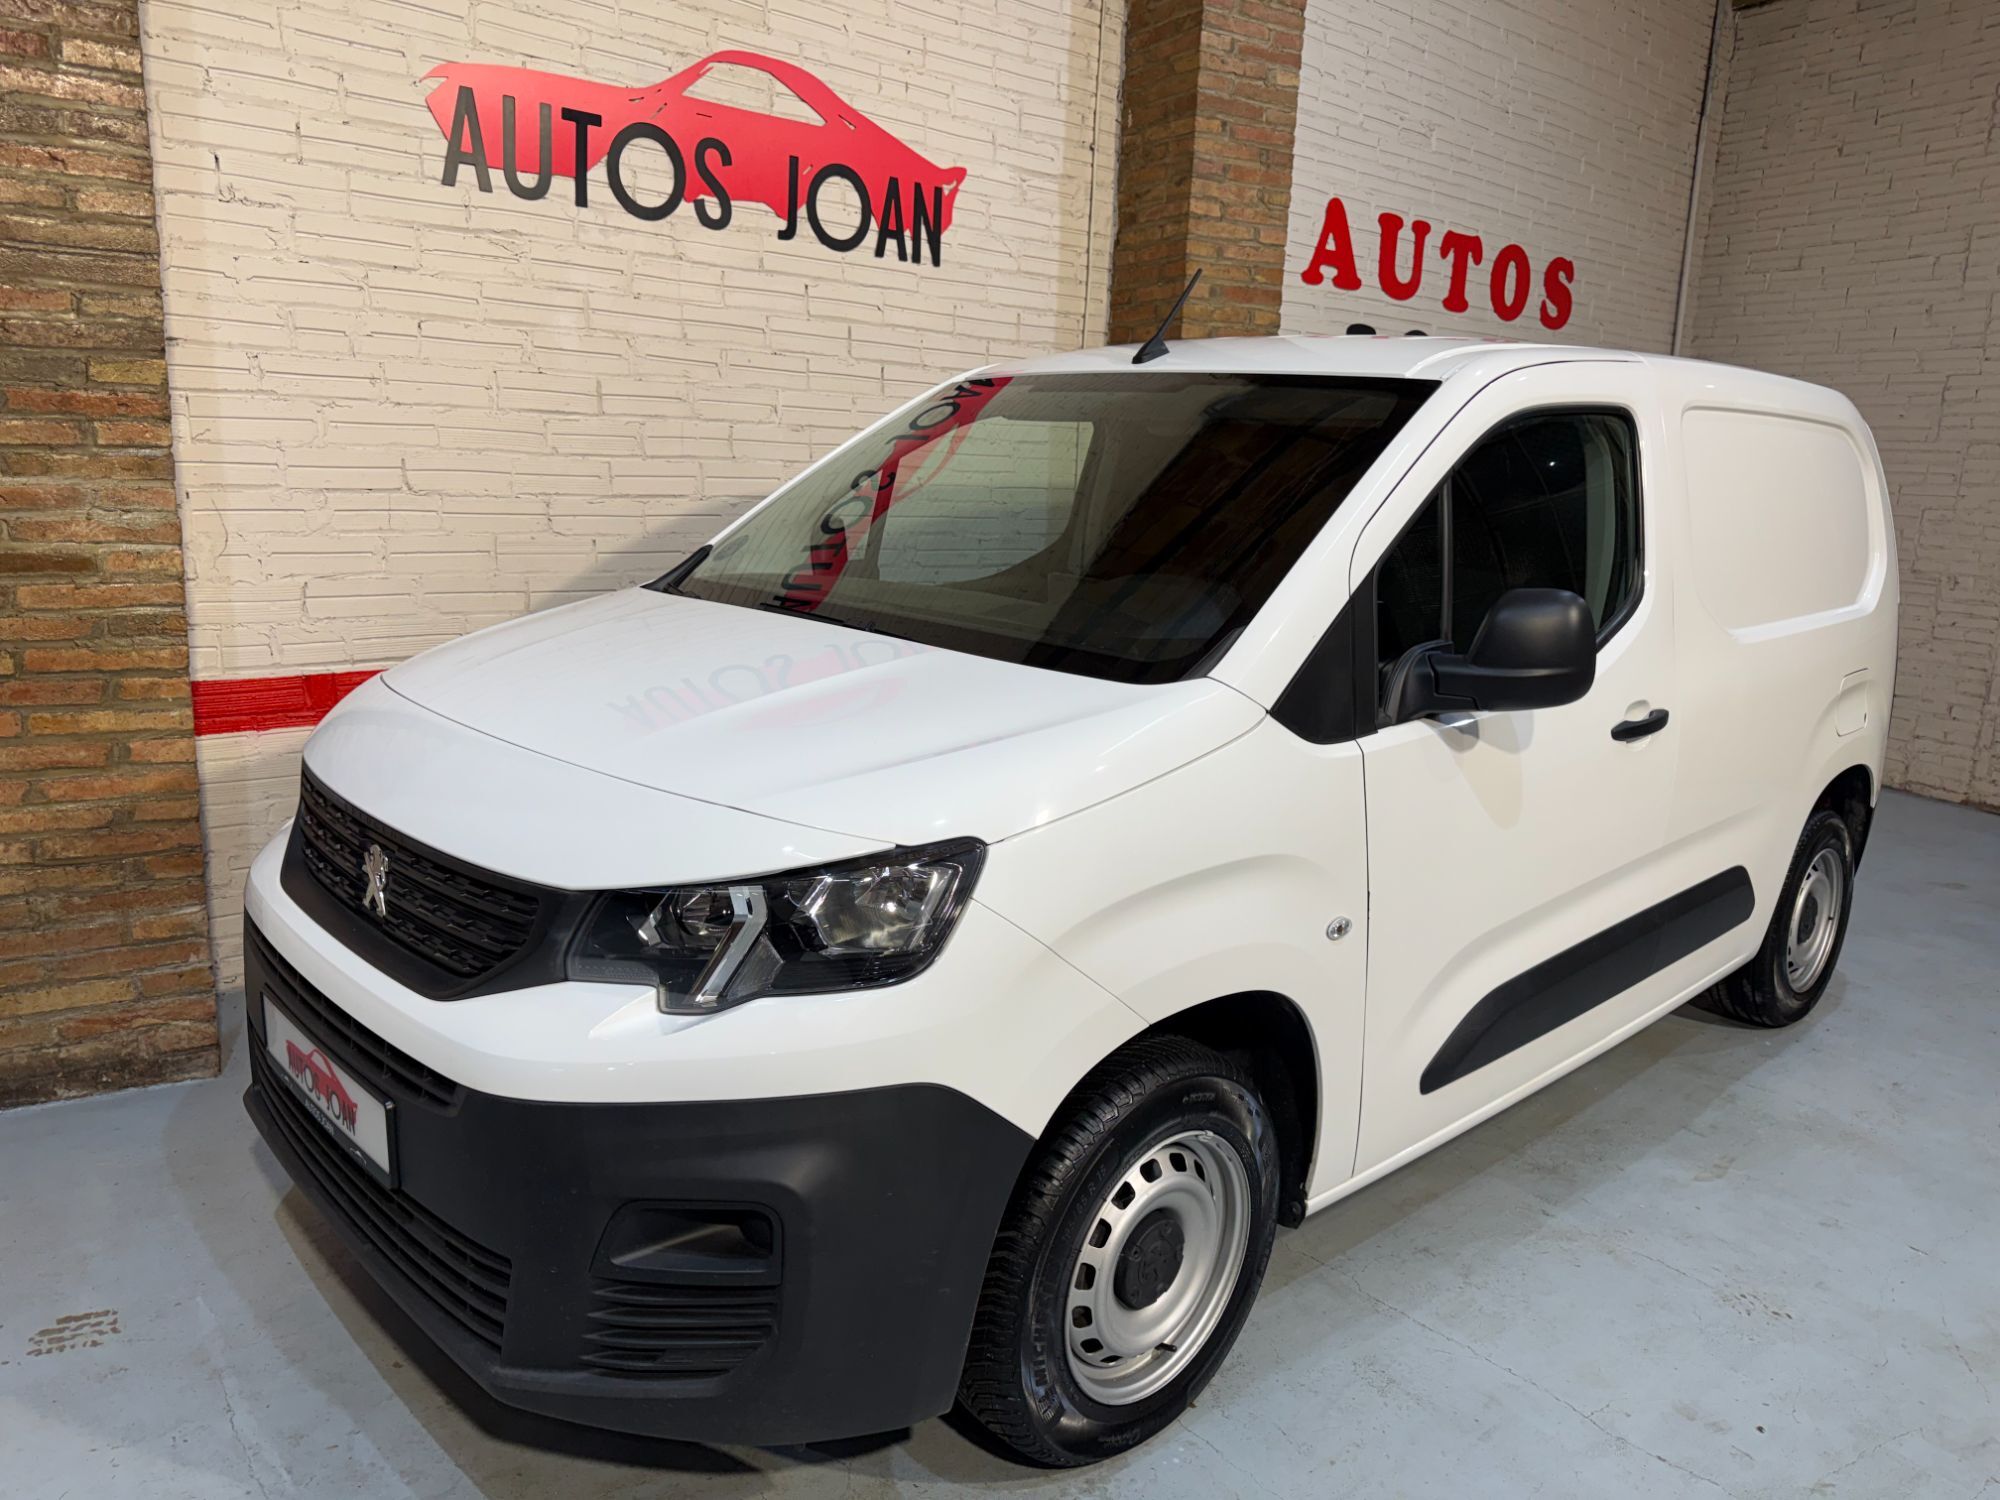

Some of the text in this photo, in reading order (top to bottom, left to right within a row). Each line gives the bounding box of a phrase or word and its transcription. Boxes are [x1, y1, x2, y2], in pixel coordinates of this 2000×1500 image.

[441, 85, 943, 267] AUTOS JOAN
[1301, 197, 1574, 331] AUTOS
[287, 1047, 321, 1101] AUTOS
[325, 1084, 357, 1137] JOAN
